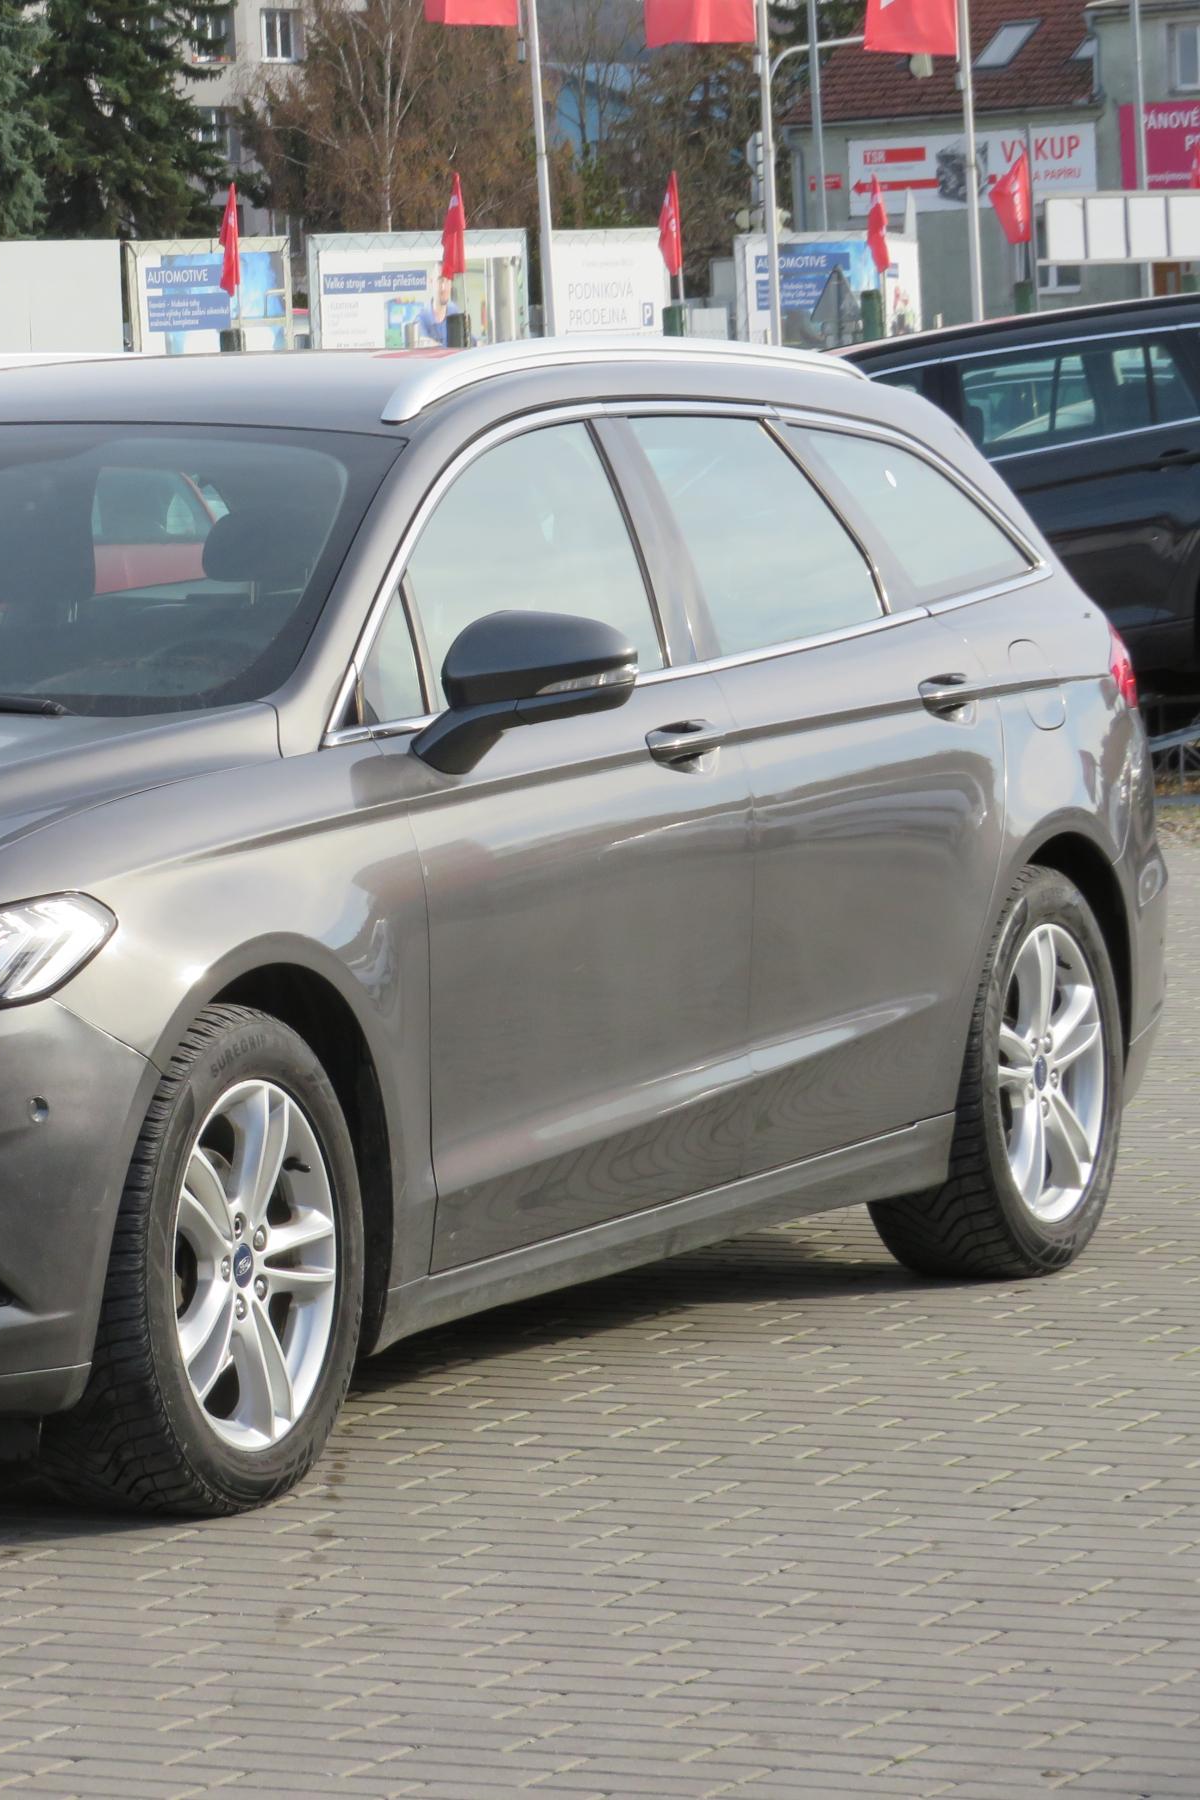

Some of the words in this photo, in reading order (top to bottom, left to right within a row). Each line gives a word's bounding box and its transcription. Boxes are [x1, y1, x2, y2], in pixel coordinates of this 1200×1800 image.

[1001, 134, 1081, 164] VKUP
[757, 255, 827, 270] AOMOTIVE
[147, 268, 209, 284] AUTOMOTIVE
[326, 275, 344, 289] Velké
[346, 276, 365, 293] stroje
[374, 274, 391, 287] velká
[568, 277, 634, 300] PODNIKOVÁ
[569, 305, 628, 327] PRODEJNA
